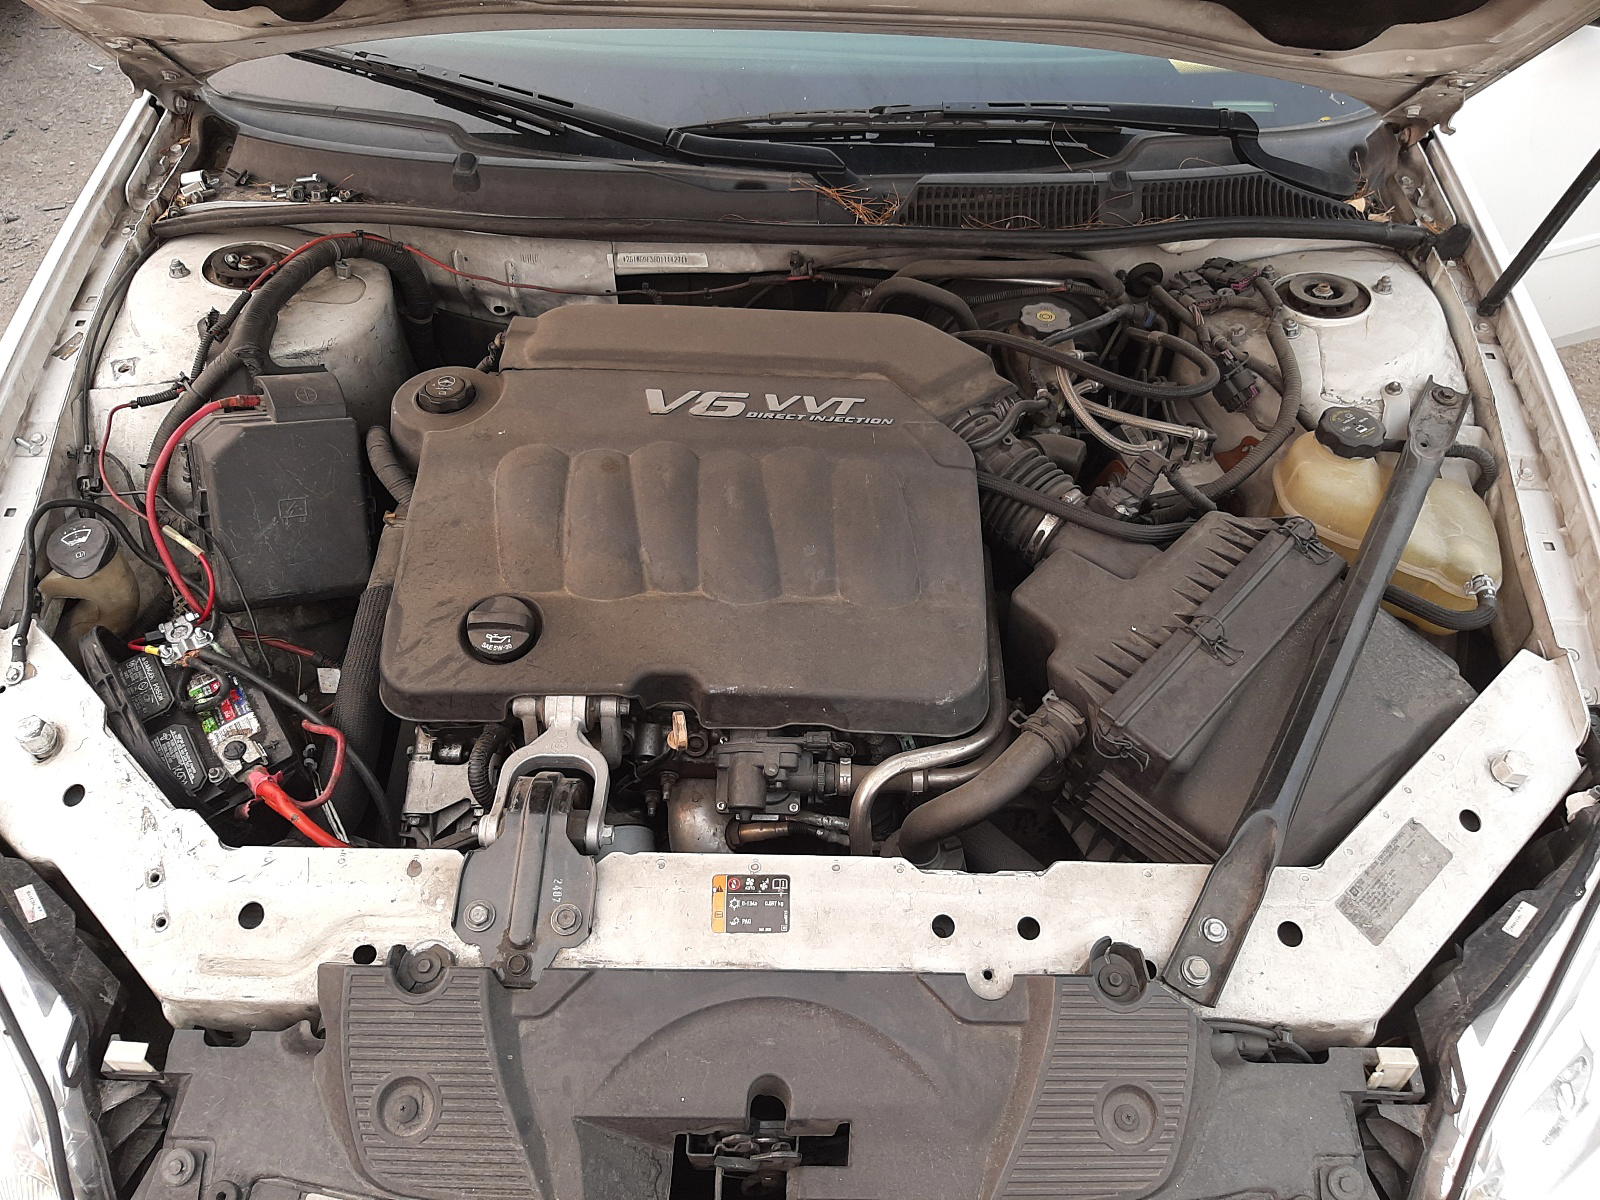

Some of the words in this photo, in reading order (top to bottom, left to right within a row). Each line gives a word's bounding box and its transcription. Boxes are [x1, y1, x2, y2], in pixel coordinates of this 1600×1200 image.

[645, 388, 750, 418] V6
[764, 393, 866, 416] VVT
[745, 411, 806, 421] DIRECT
[809, 415, 894, 425] INJECTION
